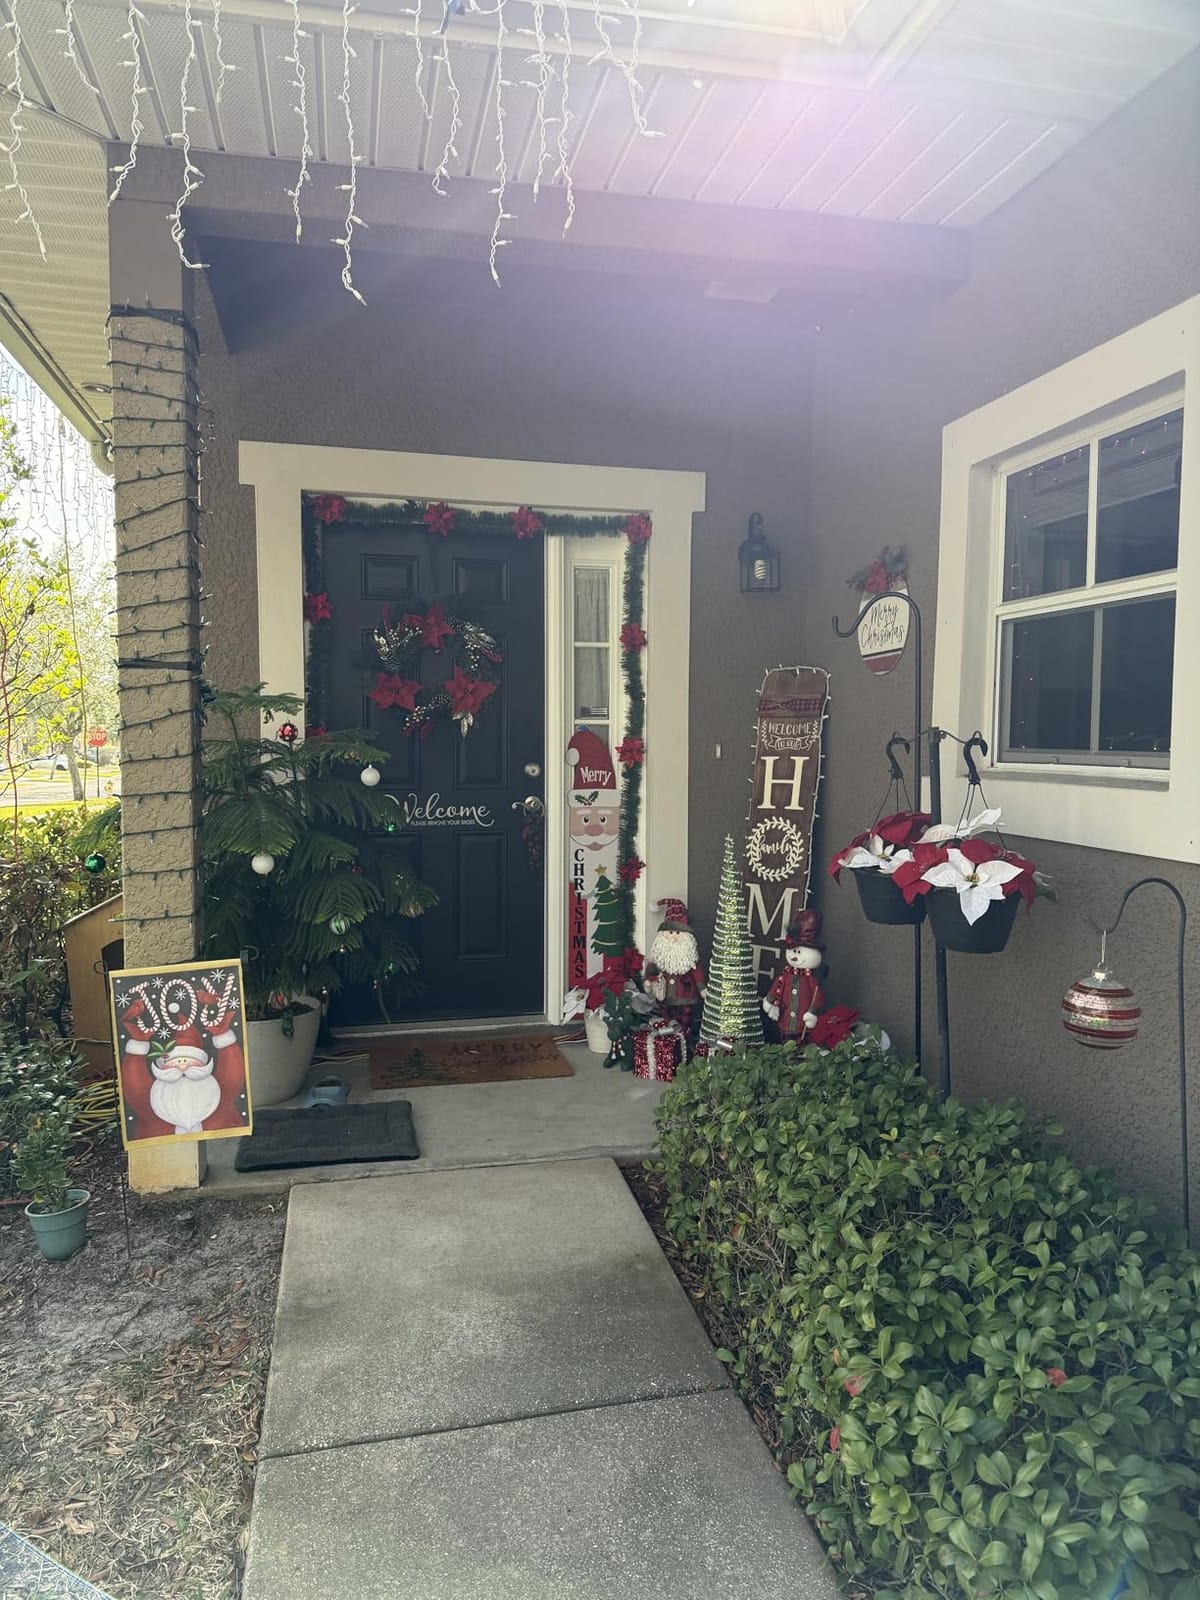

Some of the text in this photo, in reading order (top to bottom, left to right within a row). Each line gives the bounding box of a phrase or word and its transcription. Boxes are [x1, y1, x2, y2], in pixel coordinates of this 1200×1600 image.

[870, 602, 900, 628] Merry
[861, 623, 905, 648] Christmas
[88, 732, 107, 741] STOP
[769, 721, 812, 735] WELCOME
[580, 766, 612, 786] Merry
[384, 792, 495, 826] Welcome
[573, 848, 587, 978] CHRISTMAS
[128, 973, 235, 1034] JOY
